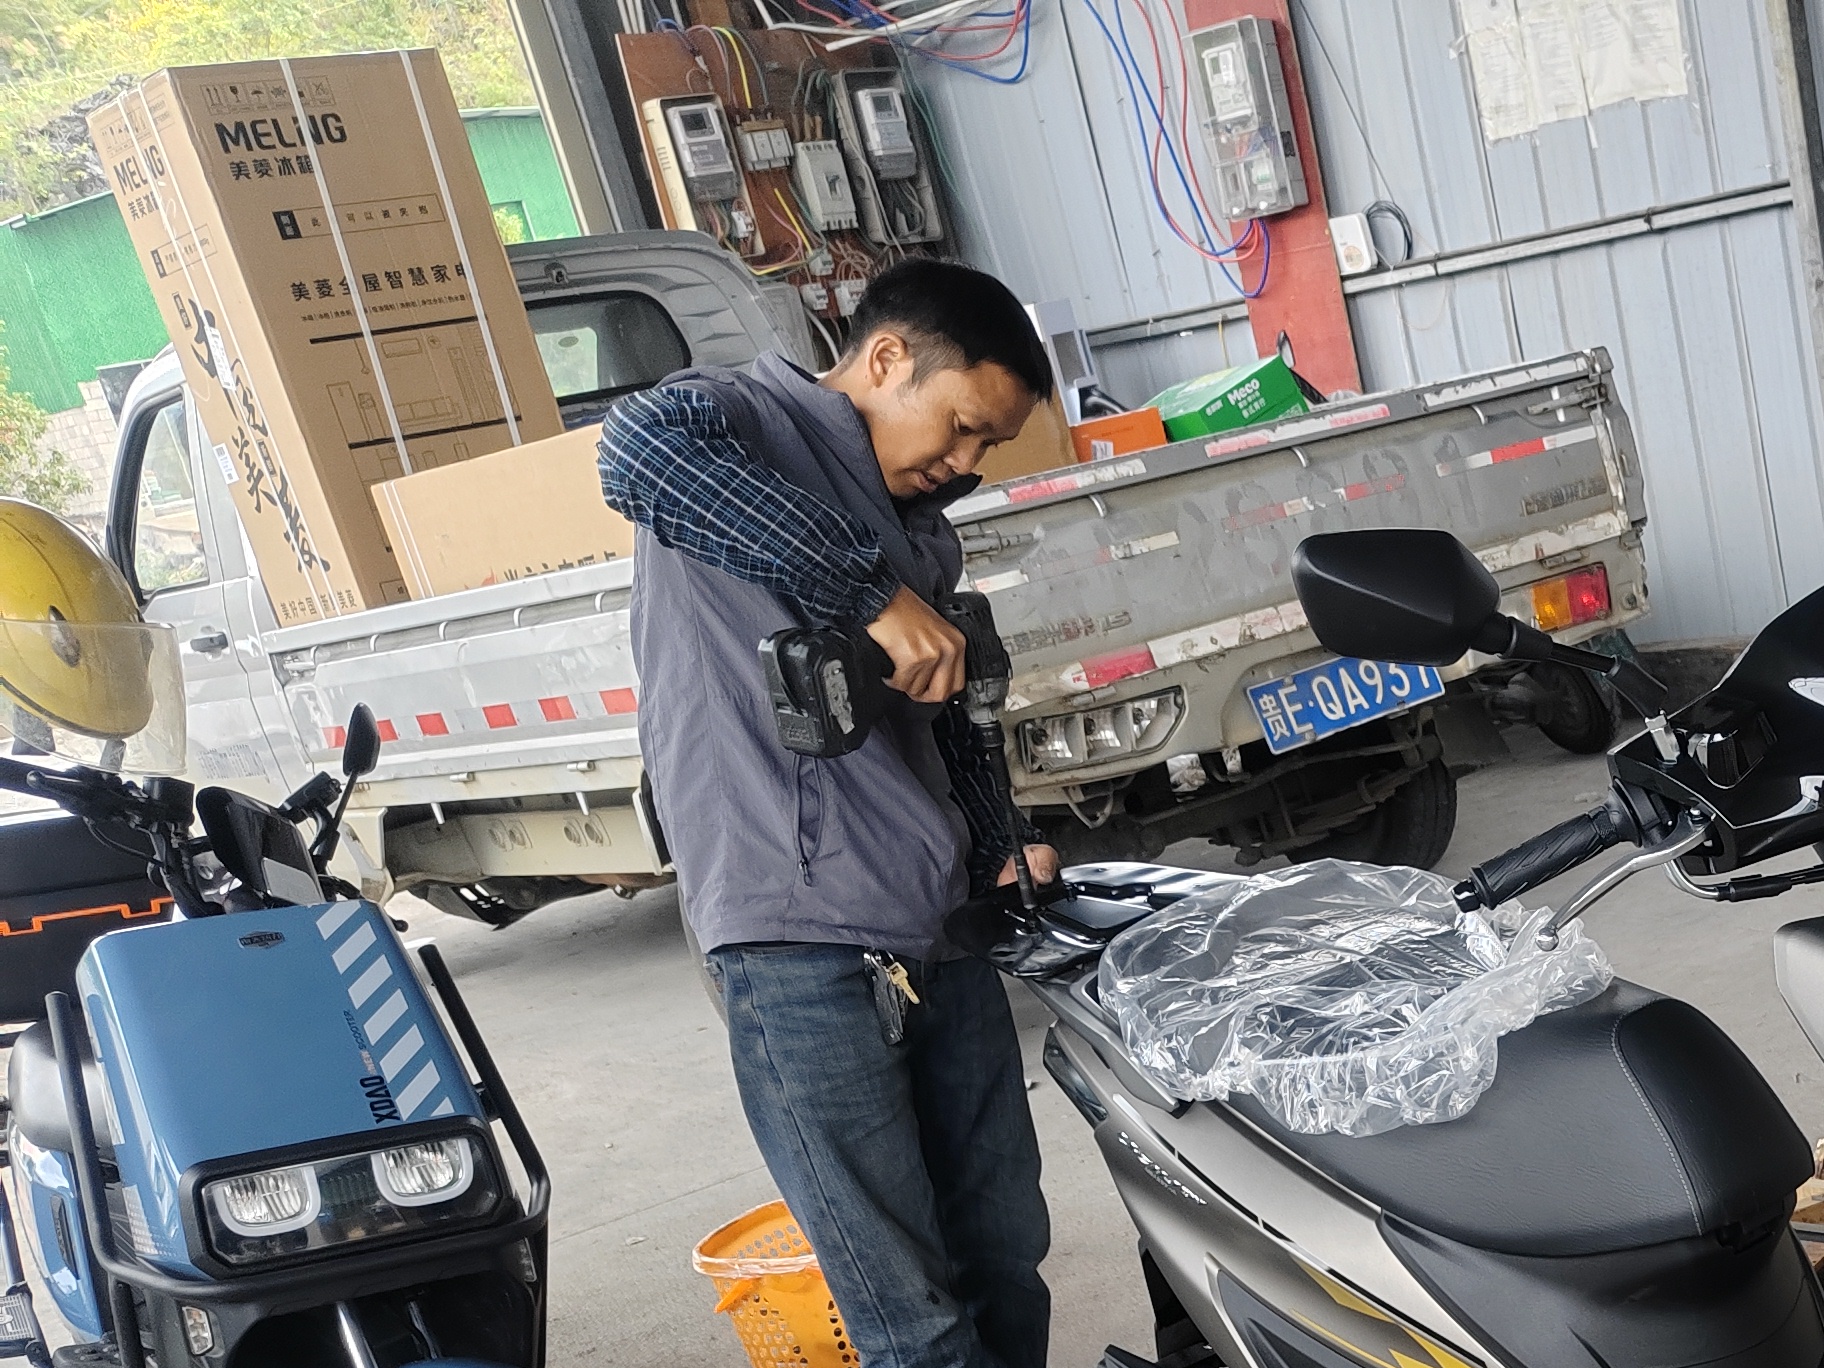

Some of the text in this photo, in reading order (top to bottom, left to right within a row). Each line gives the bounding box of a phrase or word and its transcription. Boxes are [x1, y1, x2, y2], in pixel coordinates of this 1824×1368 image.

[113, 144, 166, 196] MELNG
[1227, 378, 1260, 406] Meco
[359, 1075, 401, 1125] XDAO
